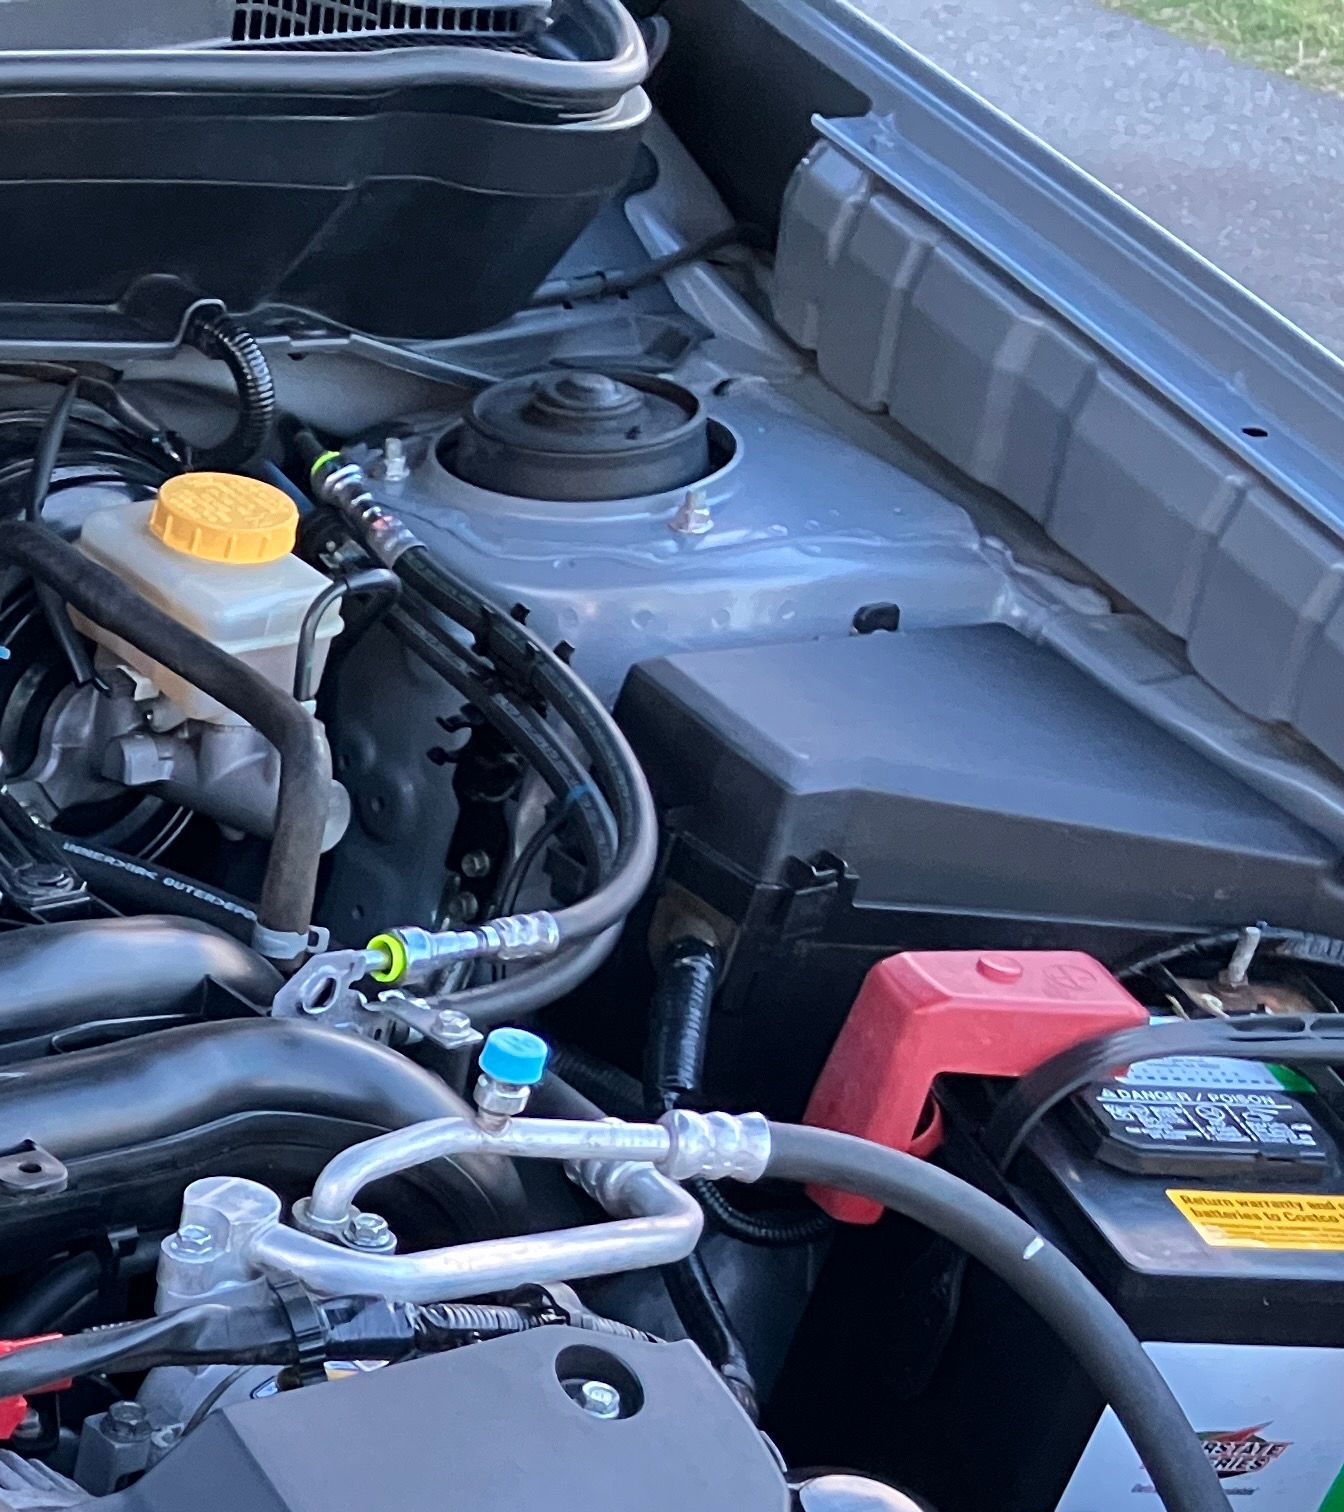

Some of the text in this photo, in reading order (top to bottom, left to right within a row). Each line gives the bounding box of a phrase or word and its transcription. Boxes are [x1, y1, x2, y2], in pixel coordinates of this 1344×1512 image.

[1117, 1088, 1192, 1102] DANGER
[1208, 1093, 1276, 1106] POISON
[1179, 1194, 1234, 1207] Return
[1235, 1199, 1305, 1211] warranty
[1307, 1200, 1337, 1211] and
[1189, 1207, 1340, 1224] batteries to Costco
